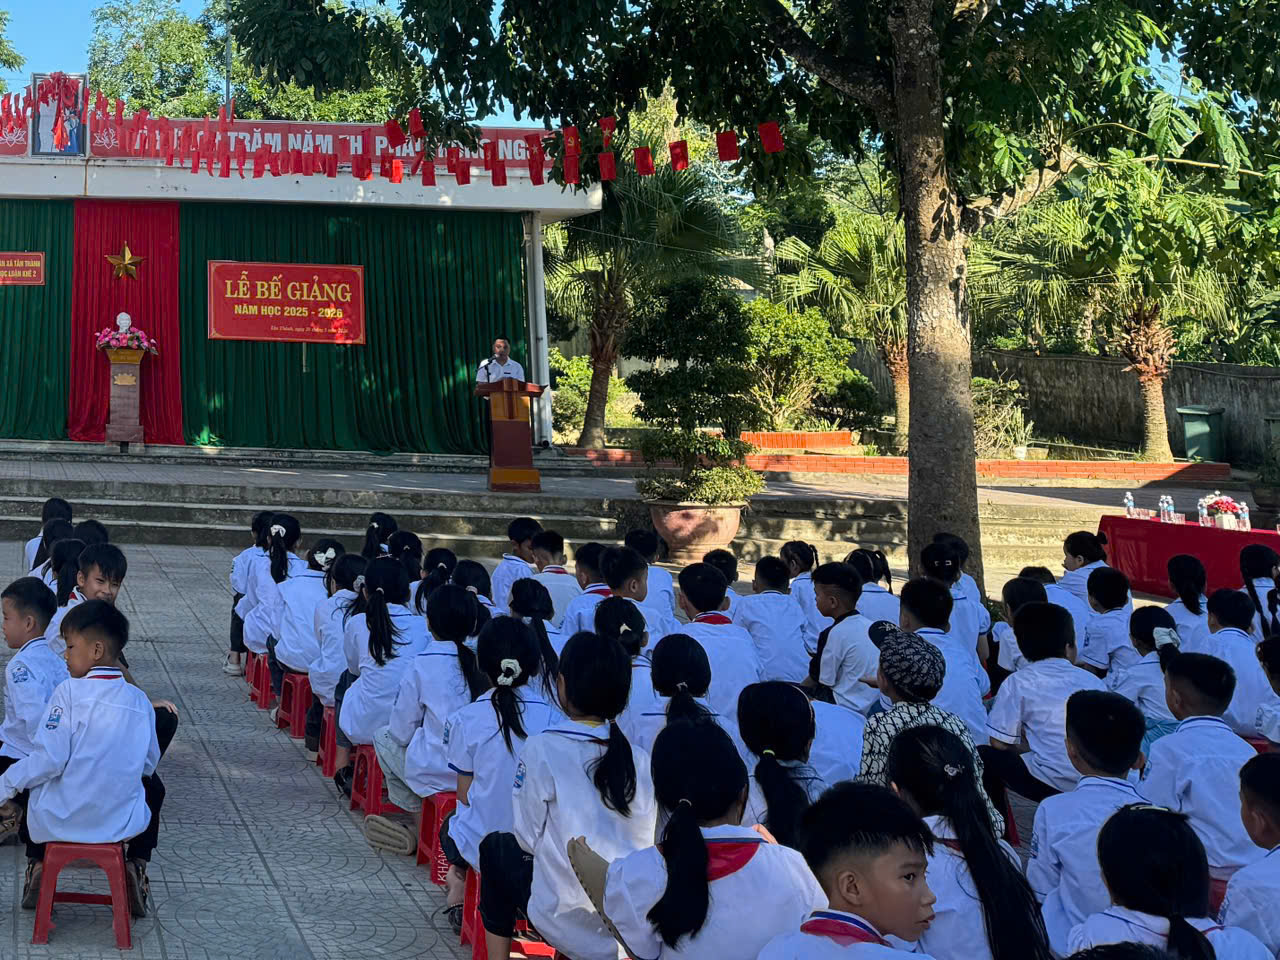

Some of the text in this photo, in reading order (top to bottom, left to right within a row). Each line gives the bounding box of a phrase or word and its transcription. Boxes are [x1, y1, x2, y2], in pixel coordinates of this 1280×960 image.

[288, 129, 333, 155] NĂM
[224, 271, 353, 303] LỄ BẾ GIẢNG
[234, 304, 258, 315] NĂM
[261, 305, 281, 318] HỌC
[284, 306, 308, 317] 2025
[317, 307, 344, 319] 2026
[434, 846, 449, 882] KHÁN
